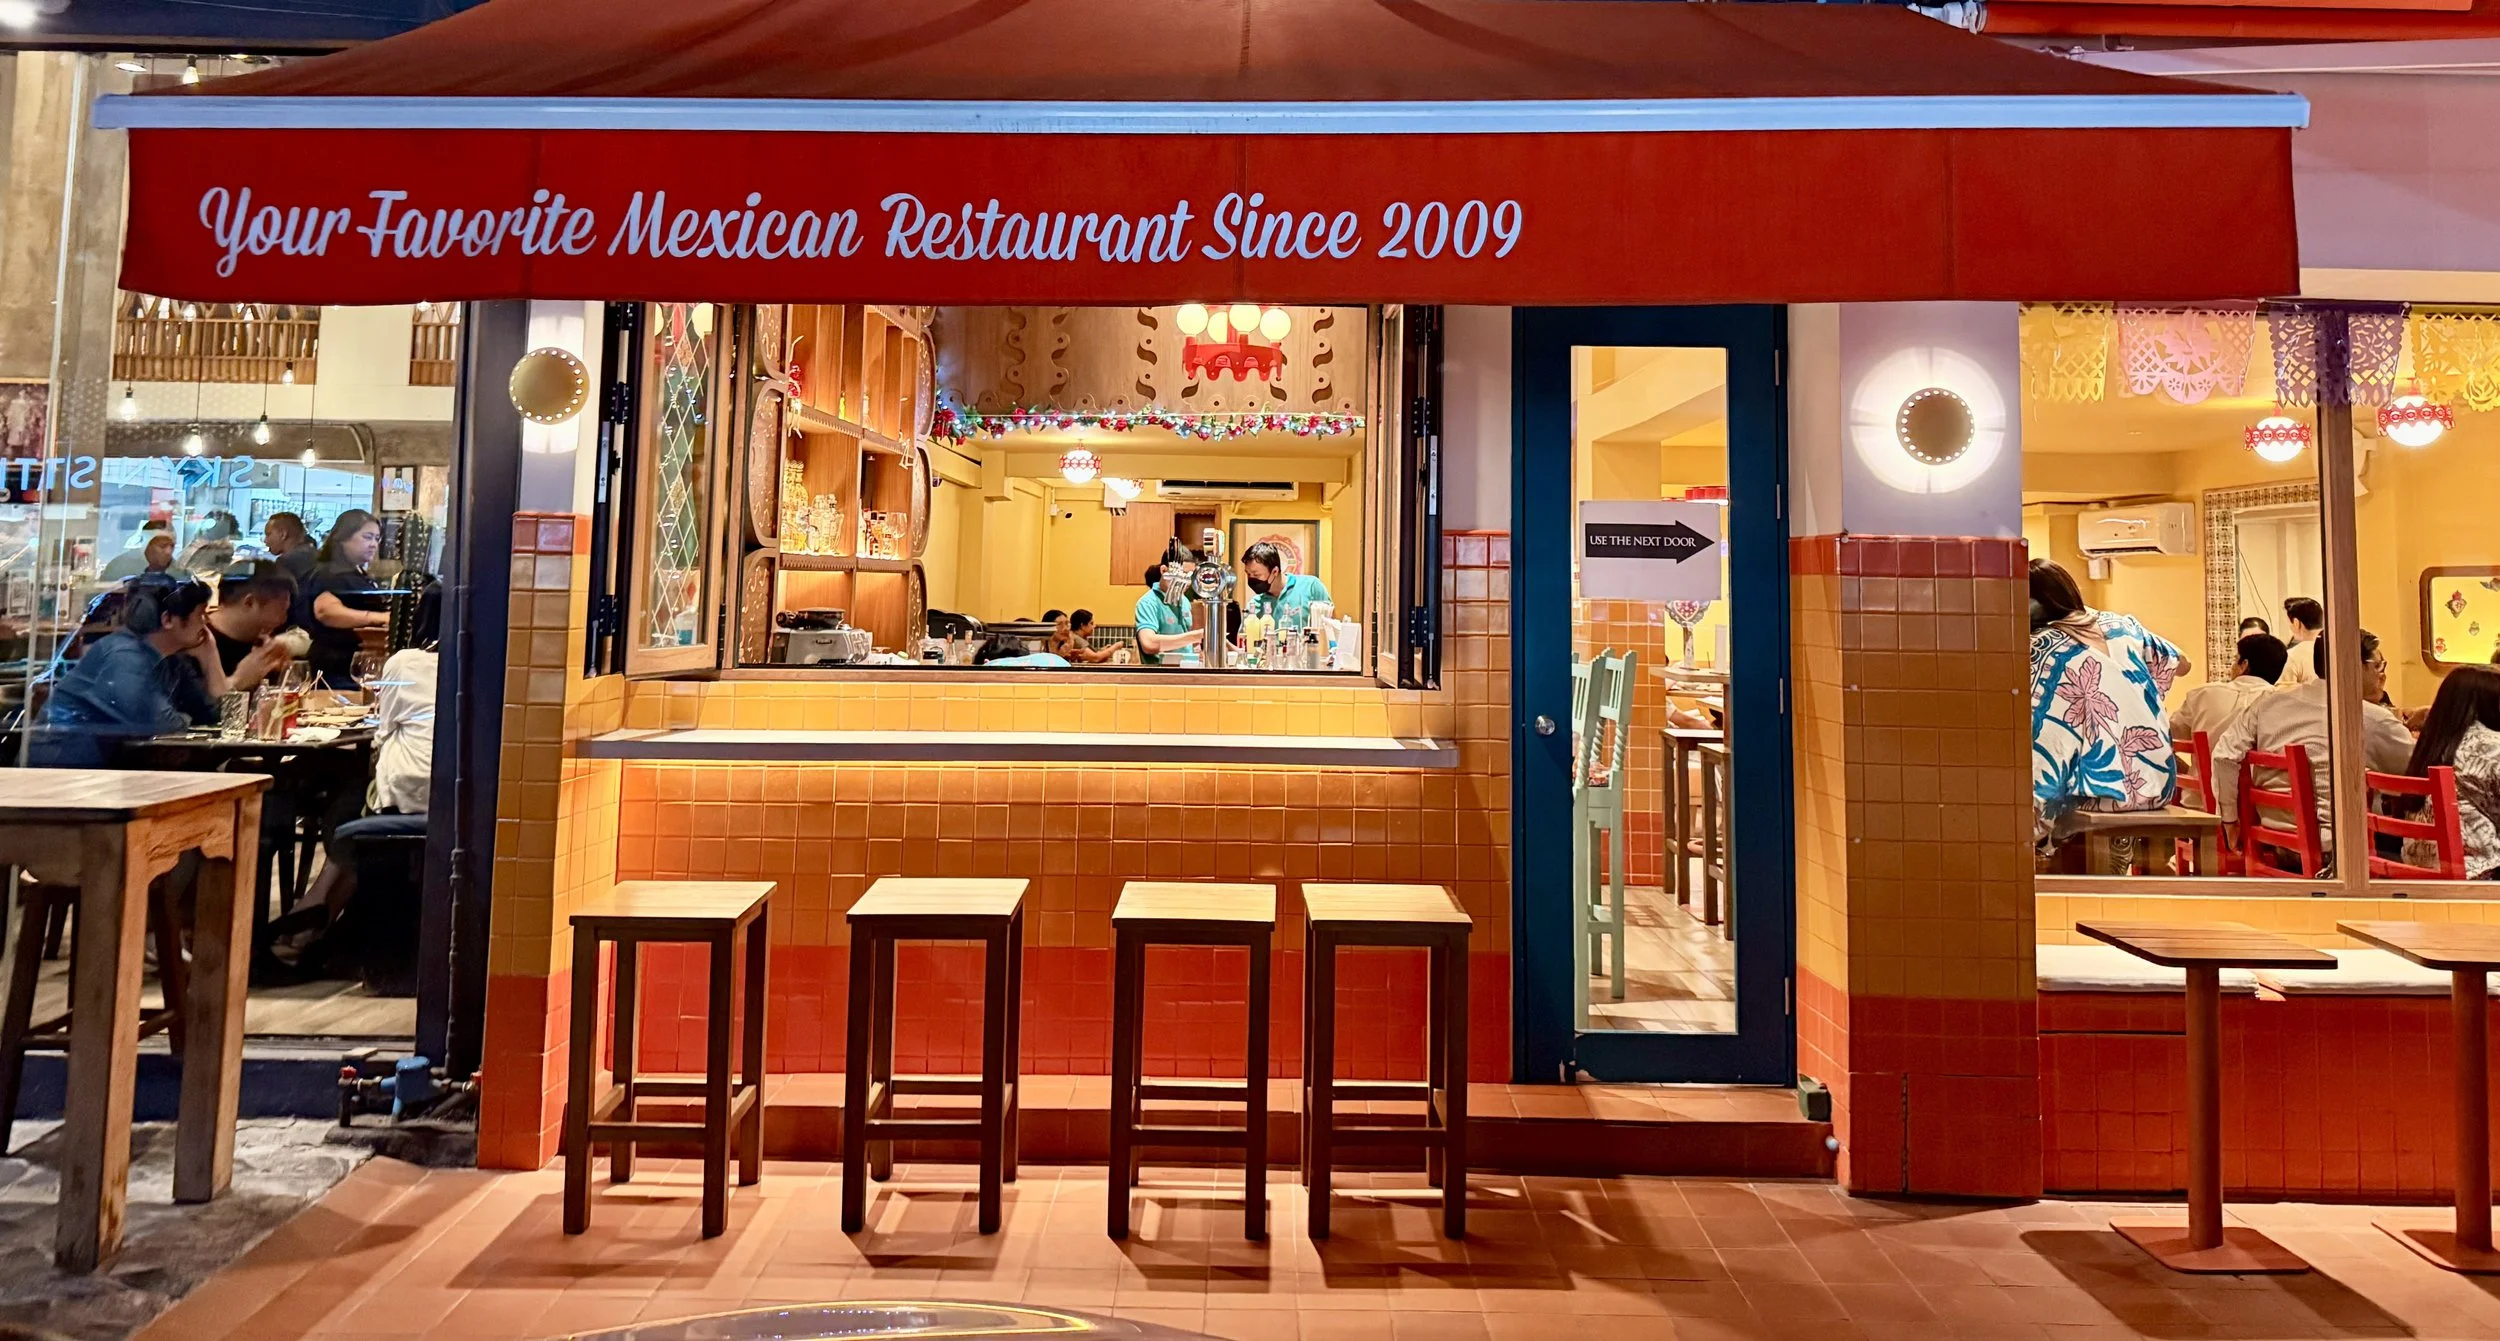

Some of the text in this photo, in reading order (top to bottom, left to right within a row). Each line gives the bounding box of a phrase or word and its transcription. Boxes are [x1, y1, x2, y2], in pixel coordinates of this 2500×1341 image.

[199, 186, 1523, 278] Your Favorite Mexican Restaurant Since 2009
[1589, 535, 1696, 547] USE THE NEXT DOOR
